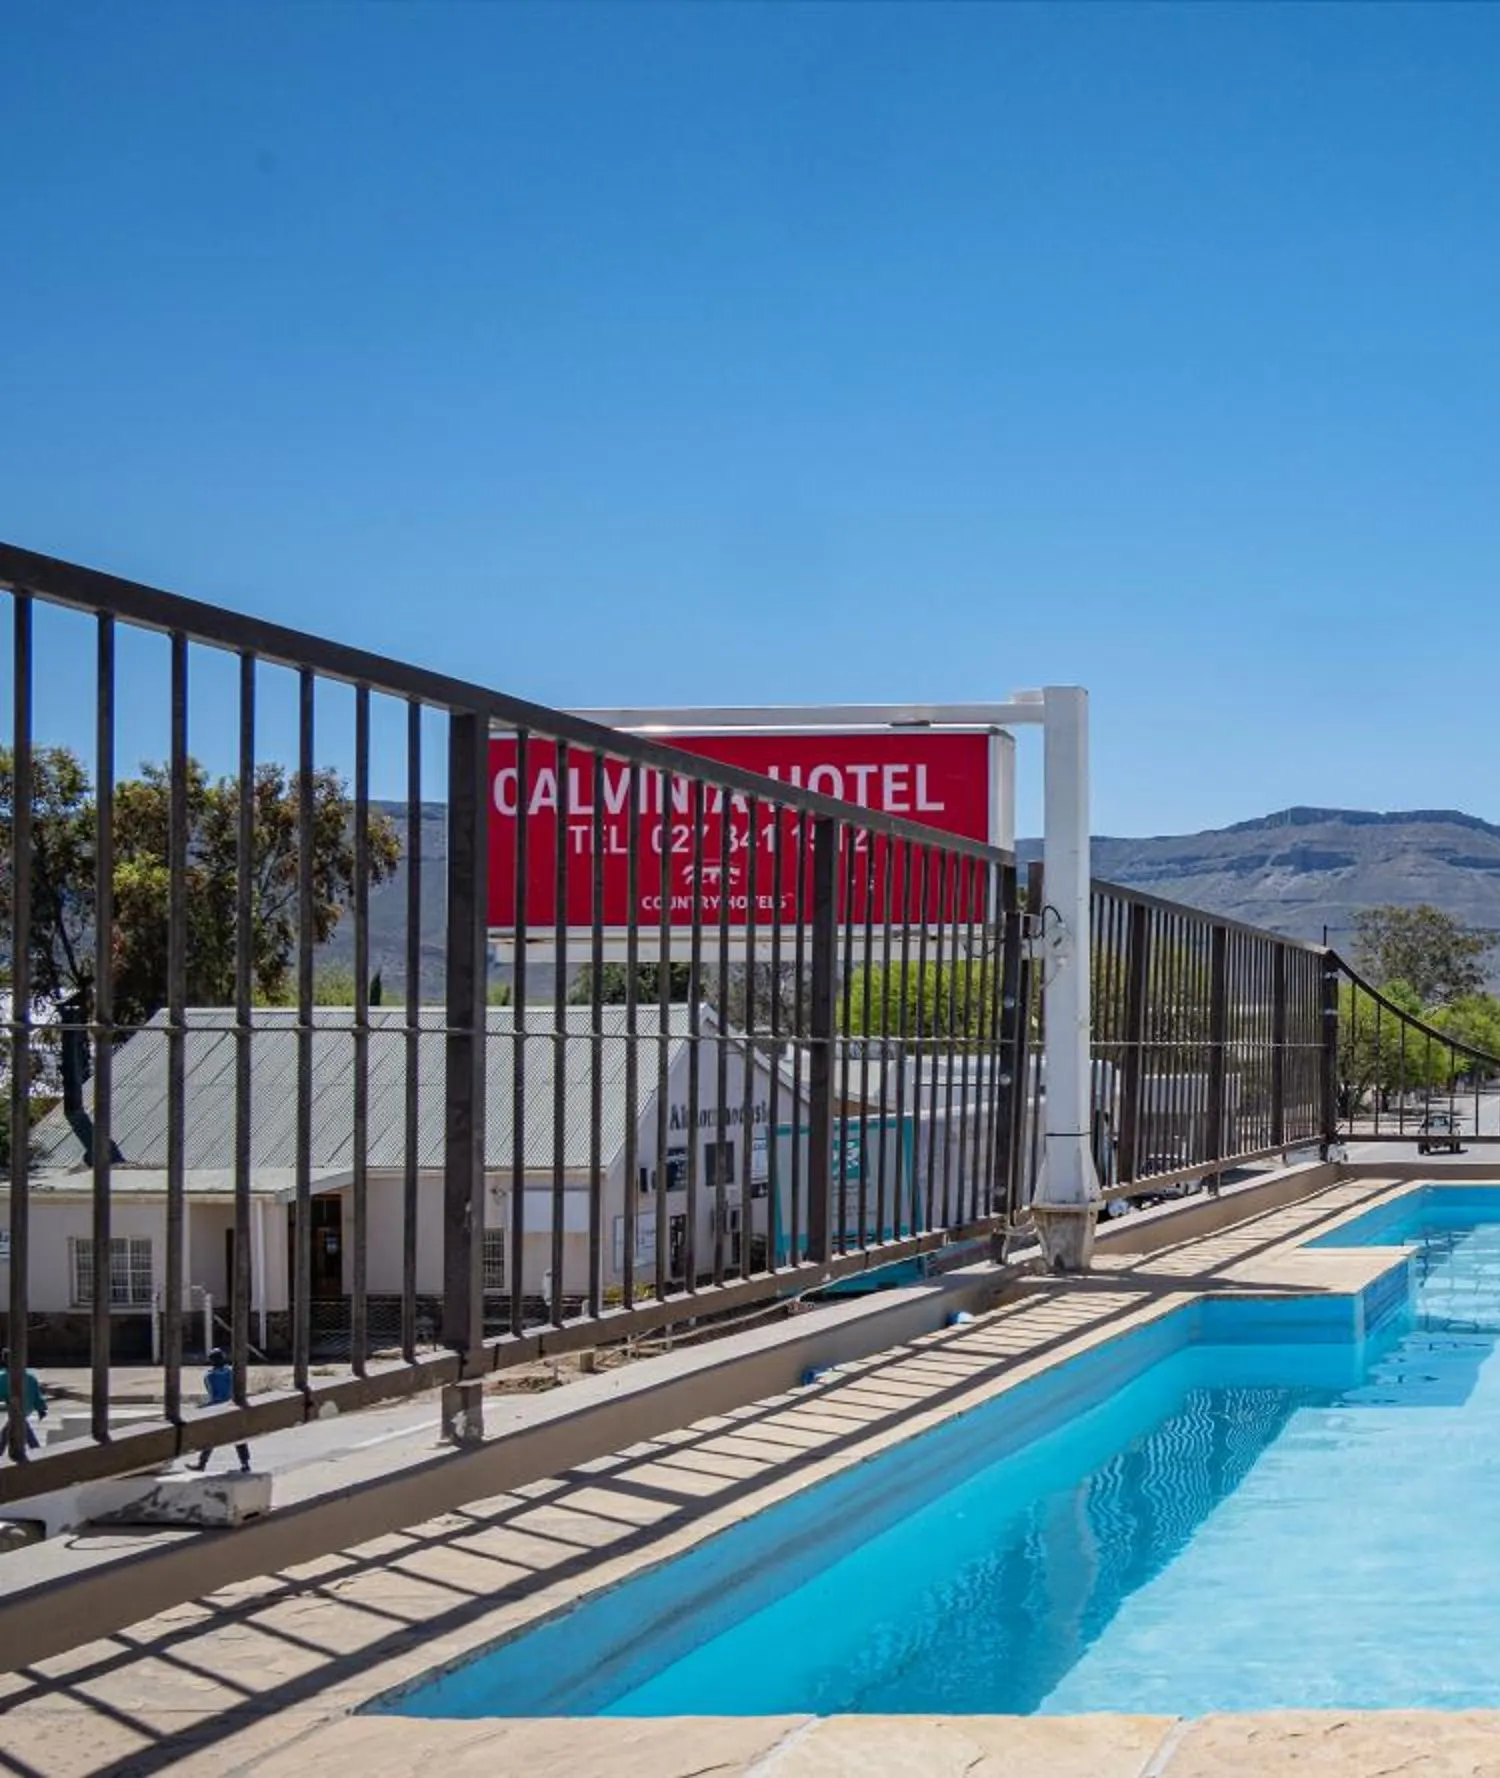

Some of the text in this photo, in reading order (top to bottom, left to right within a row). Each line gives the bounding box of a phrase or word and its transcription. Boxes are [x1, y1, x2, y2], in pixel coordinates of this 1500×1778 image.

[493, 767, 749, 816] CALVIN
[790, 821, 869, 852] 12
[641, 895, 786, 909] COUNRY HOELS
